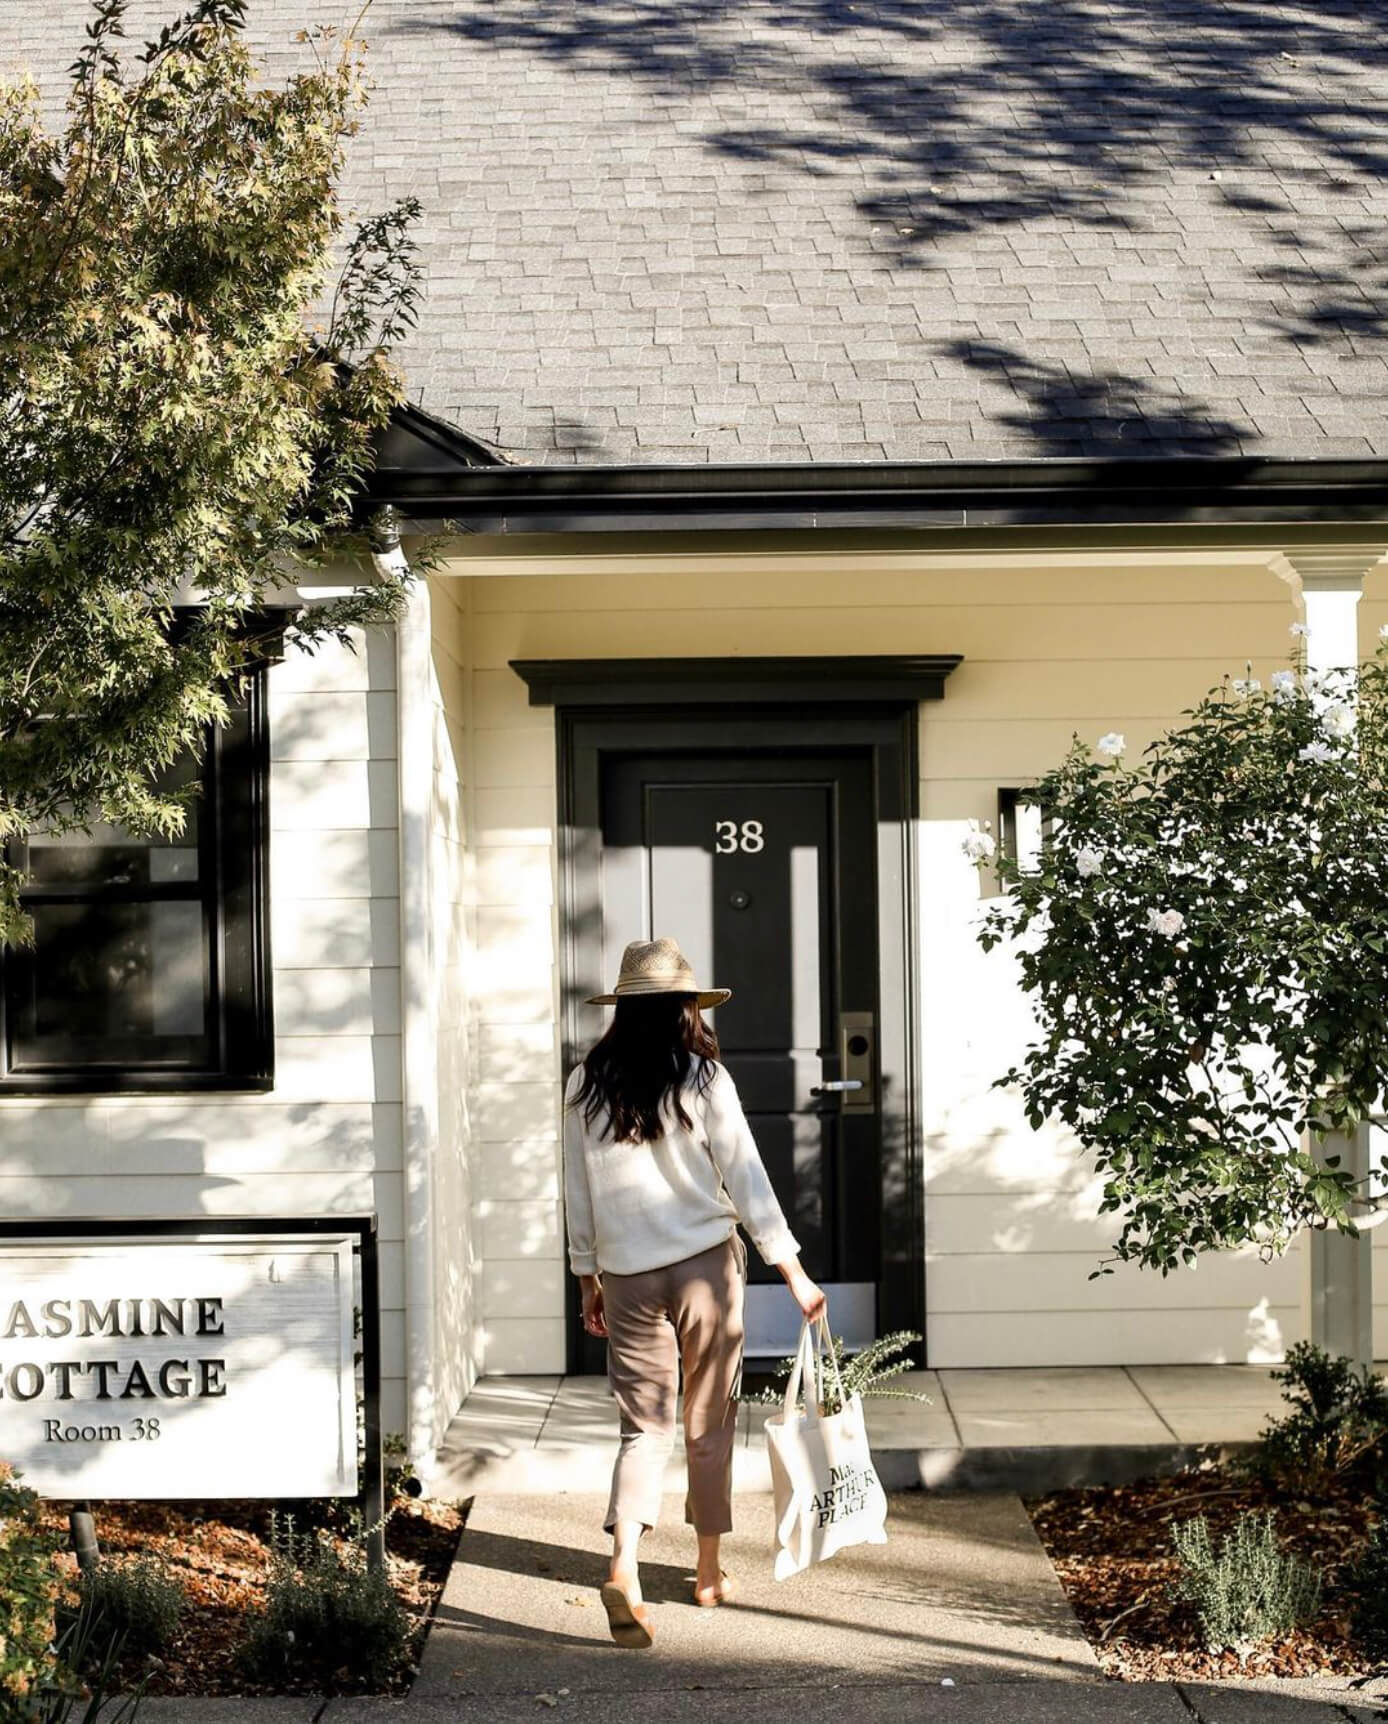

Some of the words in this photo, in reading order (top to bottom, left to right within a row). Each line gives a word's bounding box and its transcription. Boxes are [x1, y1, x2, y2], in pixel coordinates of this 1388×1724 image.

[715, 820, 765, 854] 38
[0, 1358, 227, 1402] OTTAGE
[42, 1418, 122, 1442] Room
[128, 1417, 161, 1441] 38
